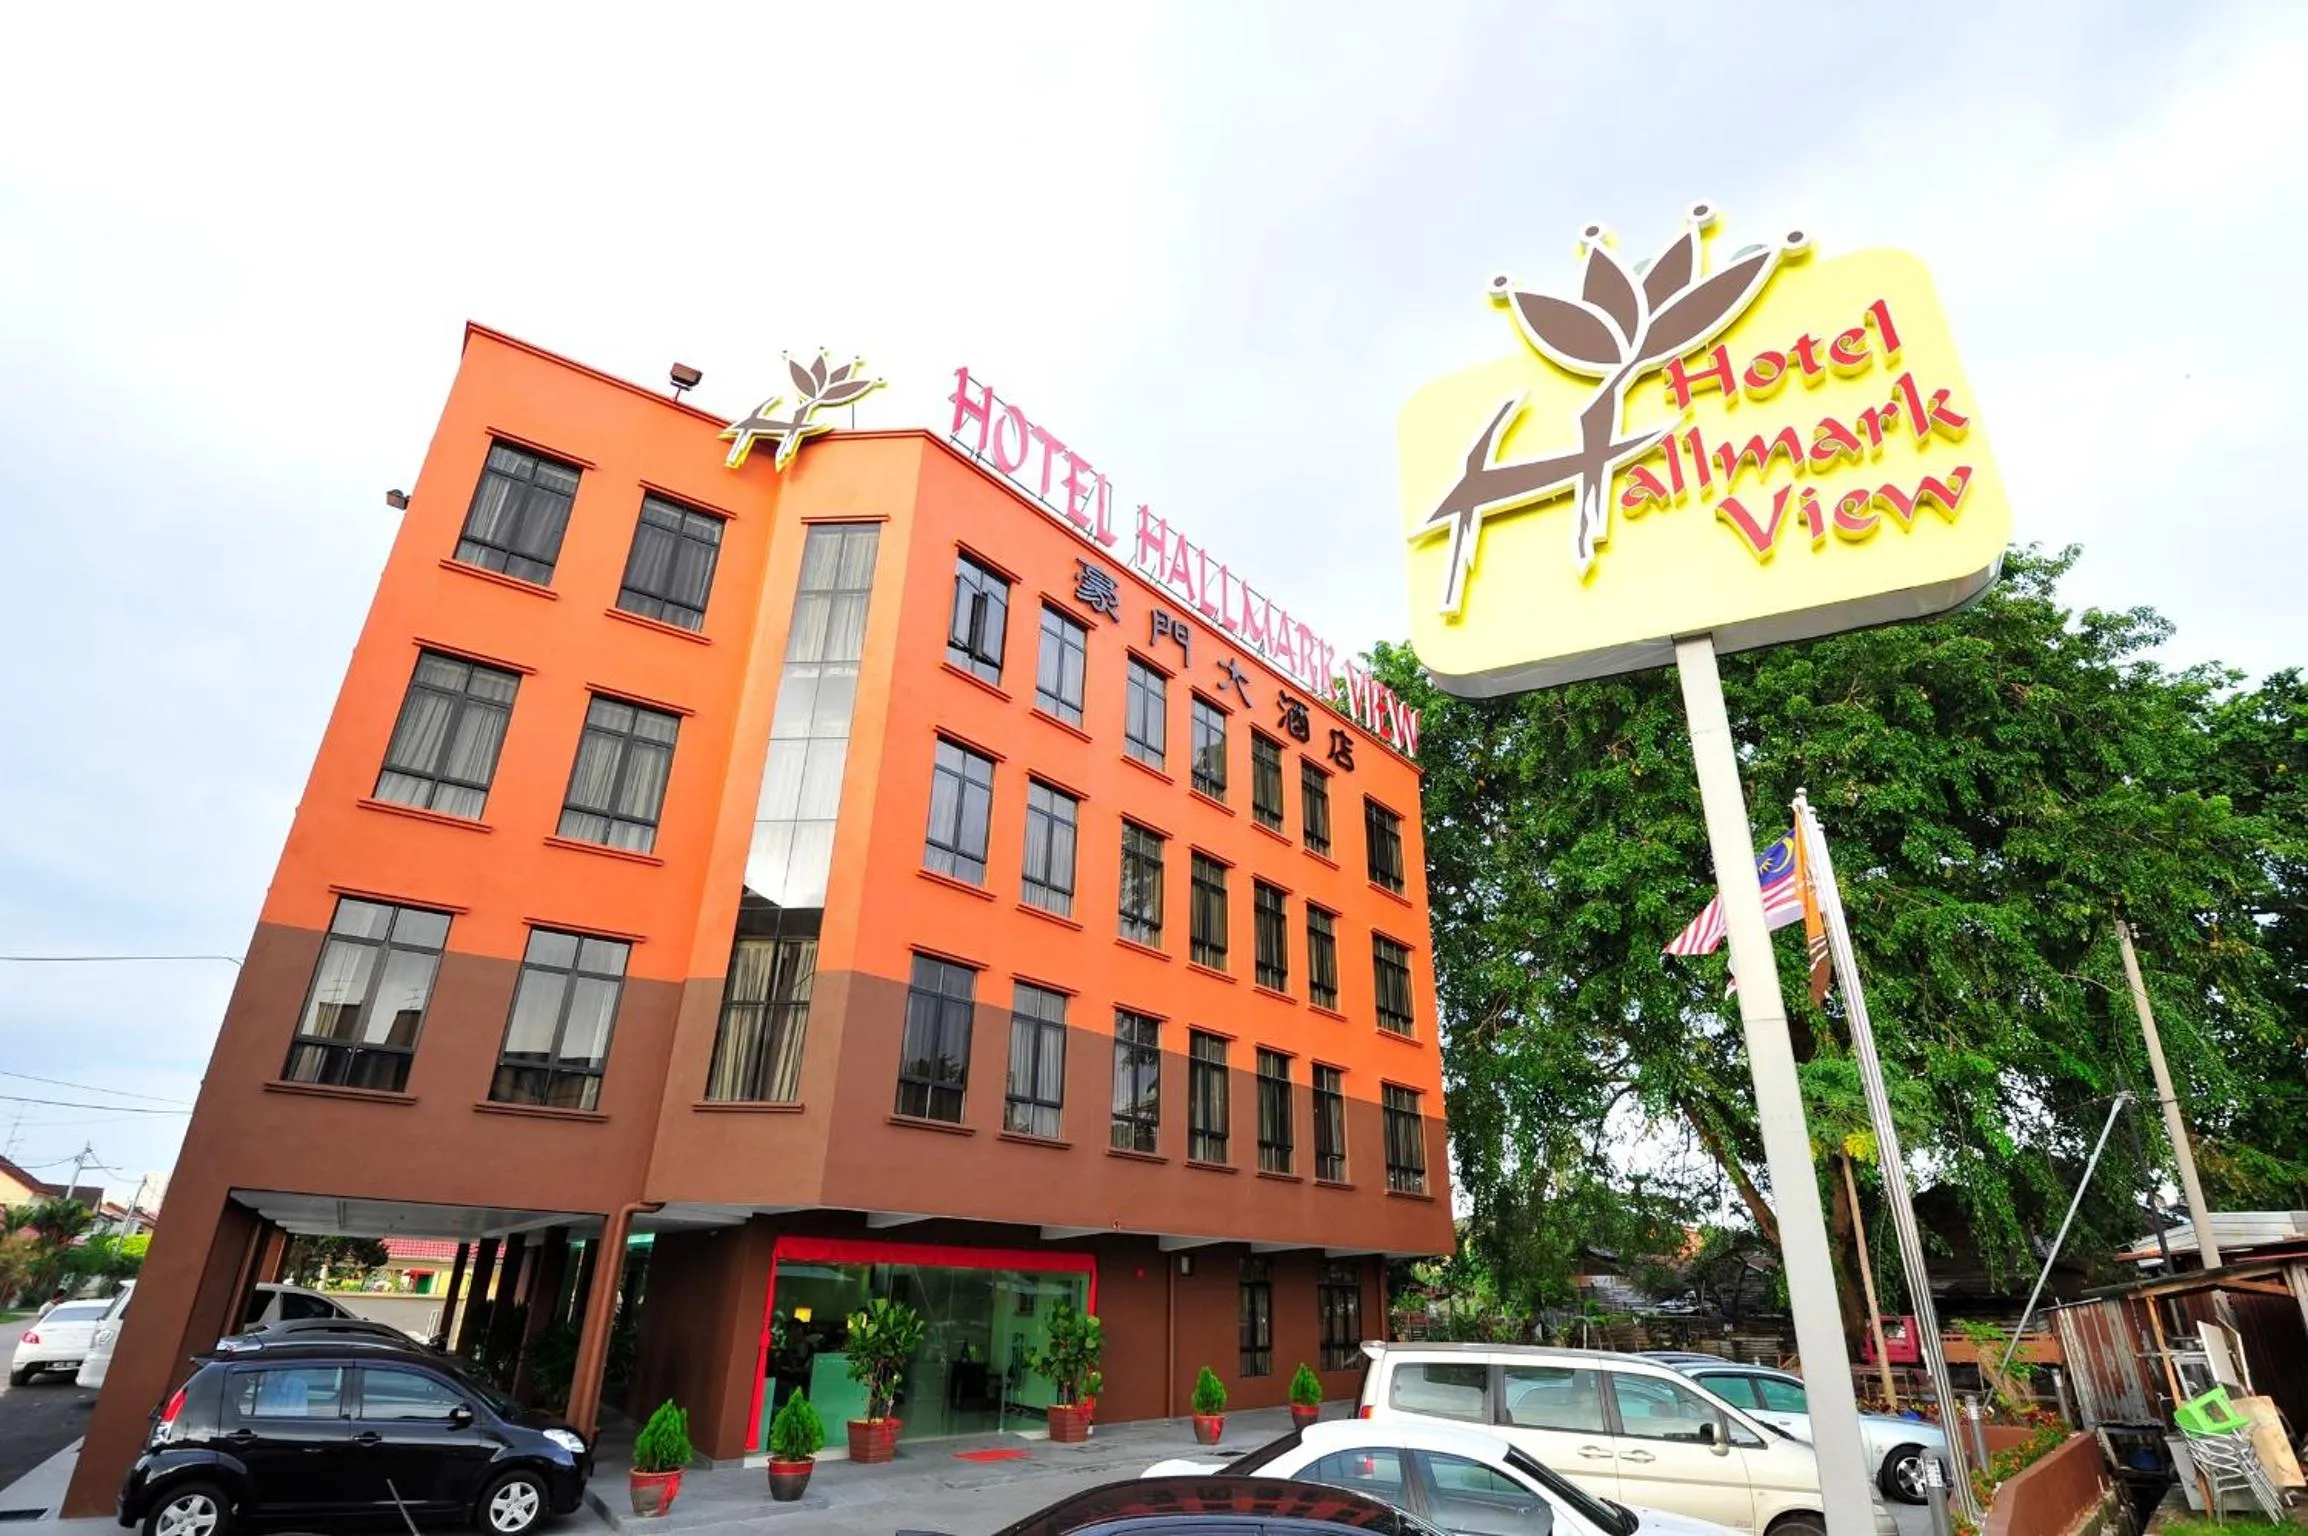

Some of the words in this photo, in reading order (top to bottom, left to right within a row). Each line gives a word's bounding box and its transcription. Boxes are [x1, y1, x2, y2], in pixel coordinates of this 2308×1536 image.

[1663, 298, 1902, 417] Hotel
[948, 366, 1118, 548] HOTEL
[1136, 503, 1338, 701] HALLMARK
[1345, 658, 1421, 758] VIEW
[1715, 464, 1974, 560] View
